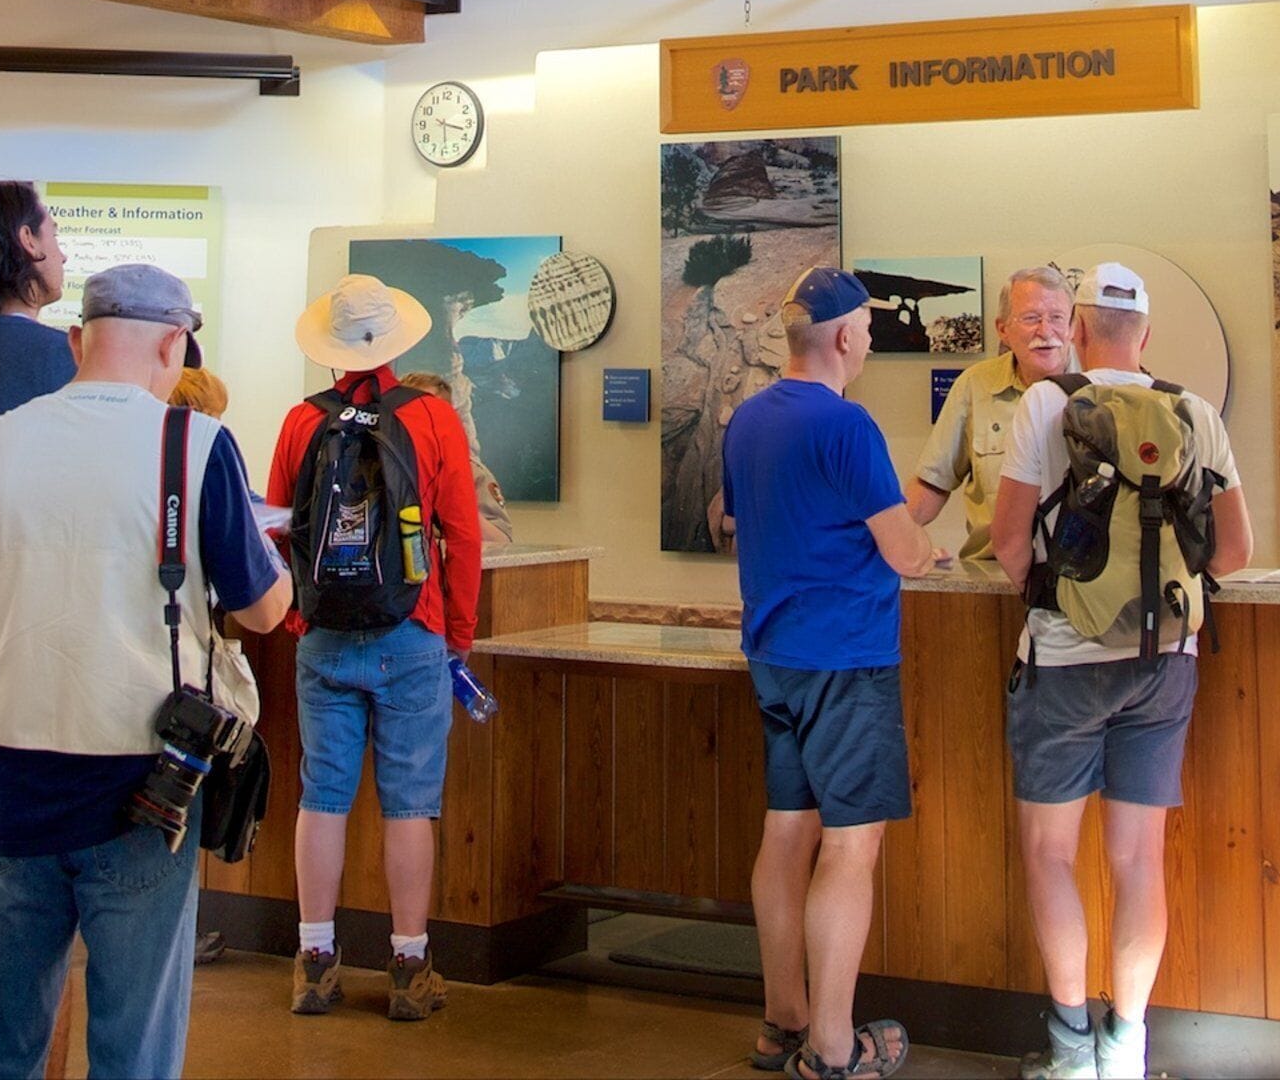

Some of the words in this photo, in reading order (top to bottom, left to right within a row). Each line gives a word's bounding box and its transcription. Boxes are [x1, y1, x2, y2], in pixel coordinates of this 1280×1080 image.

[780, 65, 859, 92] PARK
[889, 48, 1115, 88] INFORMATION
[442, 91, 452, 101] 12
[423, 106, 433, 116] 10
[462, 105, 469, 114] 2
[419, 120, 426, 130] 9
[465, 119, 473, 129] 3
[422, 133, 430, 143] 8
[452, 143, 459, 152] 5
[45, 206, 104, 218] Weather
[108, 207, 117, 218] &
[122, 207, 203, 220] Information
[85, 226, 121, 234] Forecast
[167, 494, 180, 548] Canon
